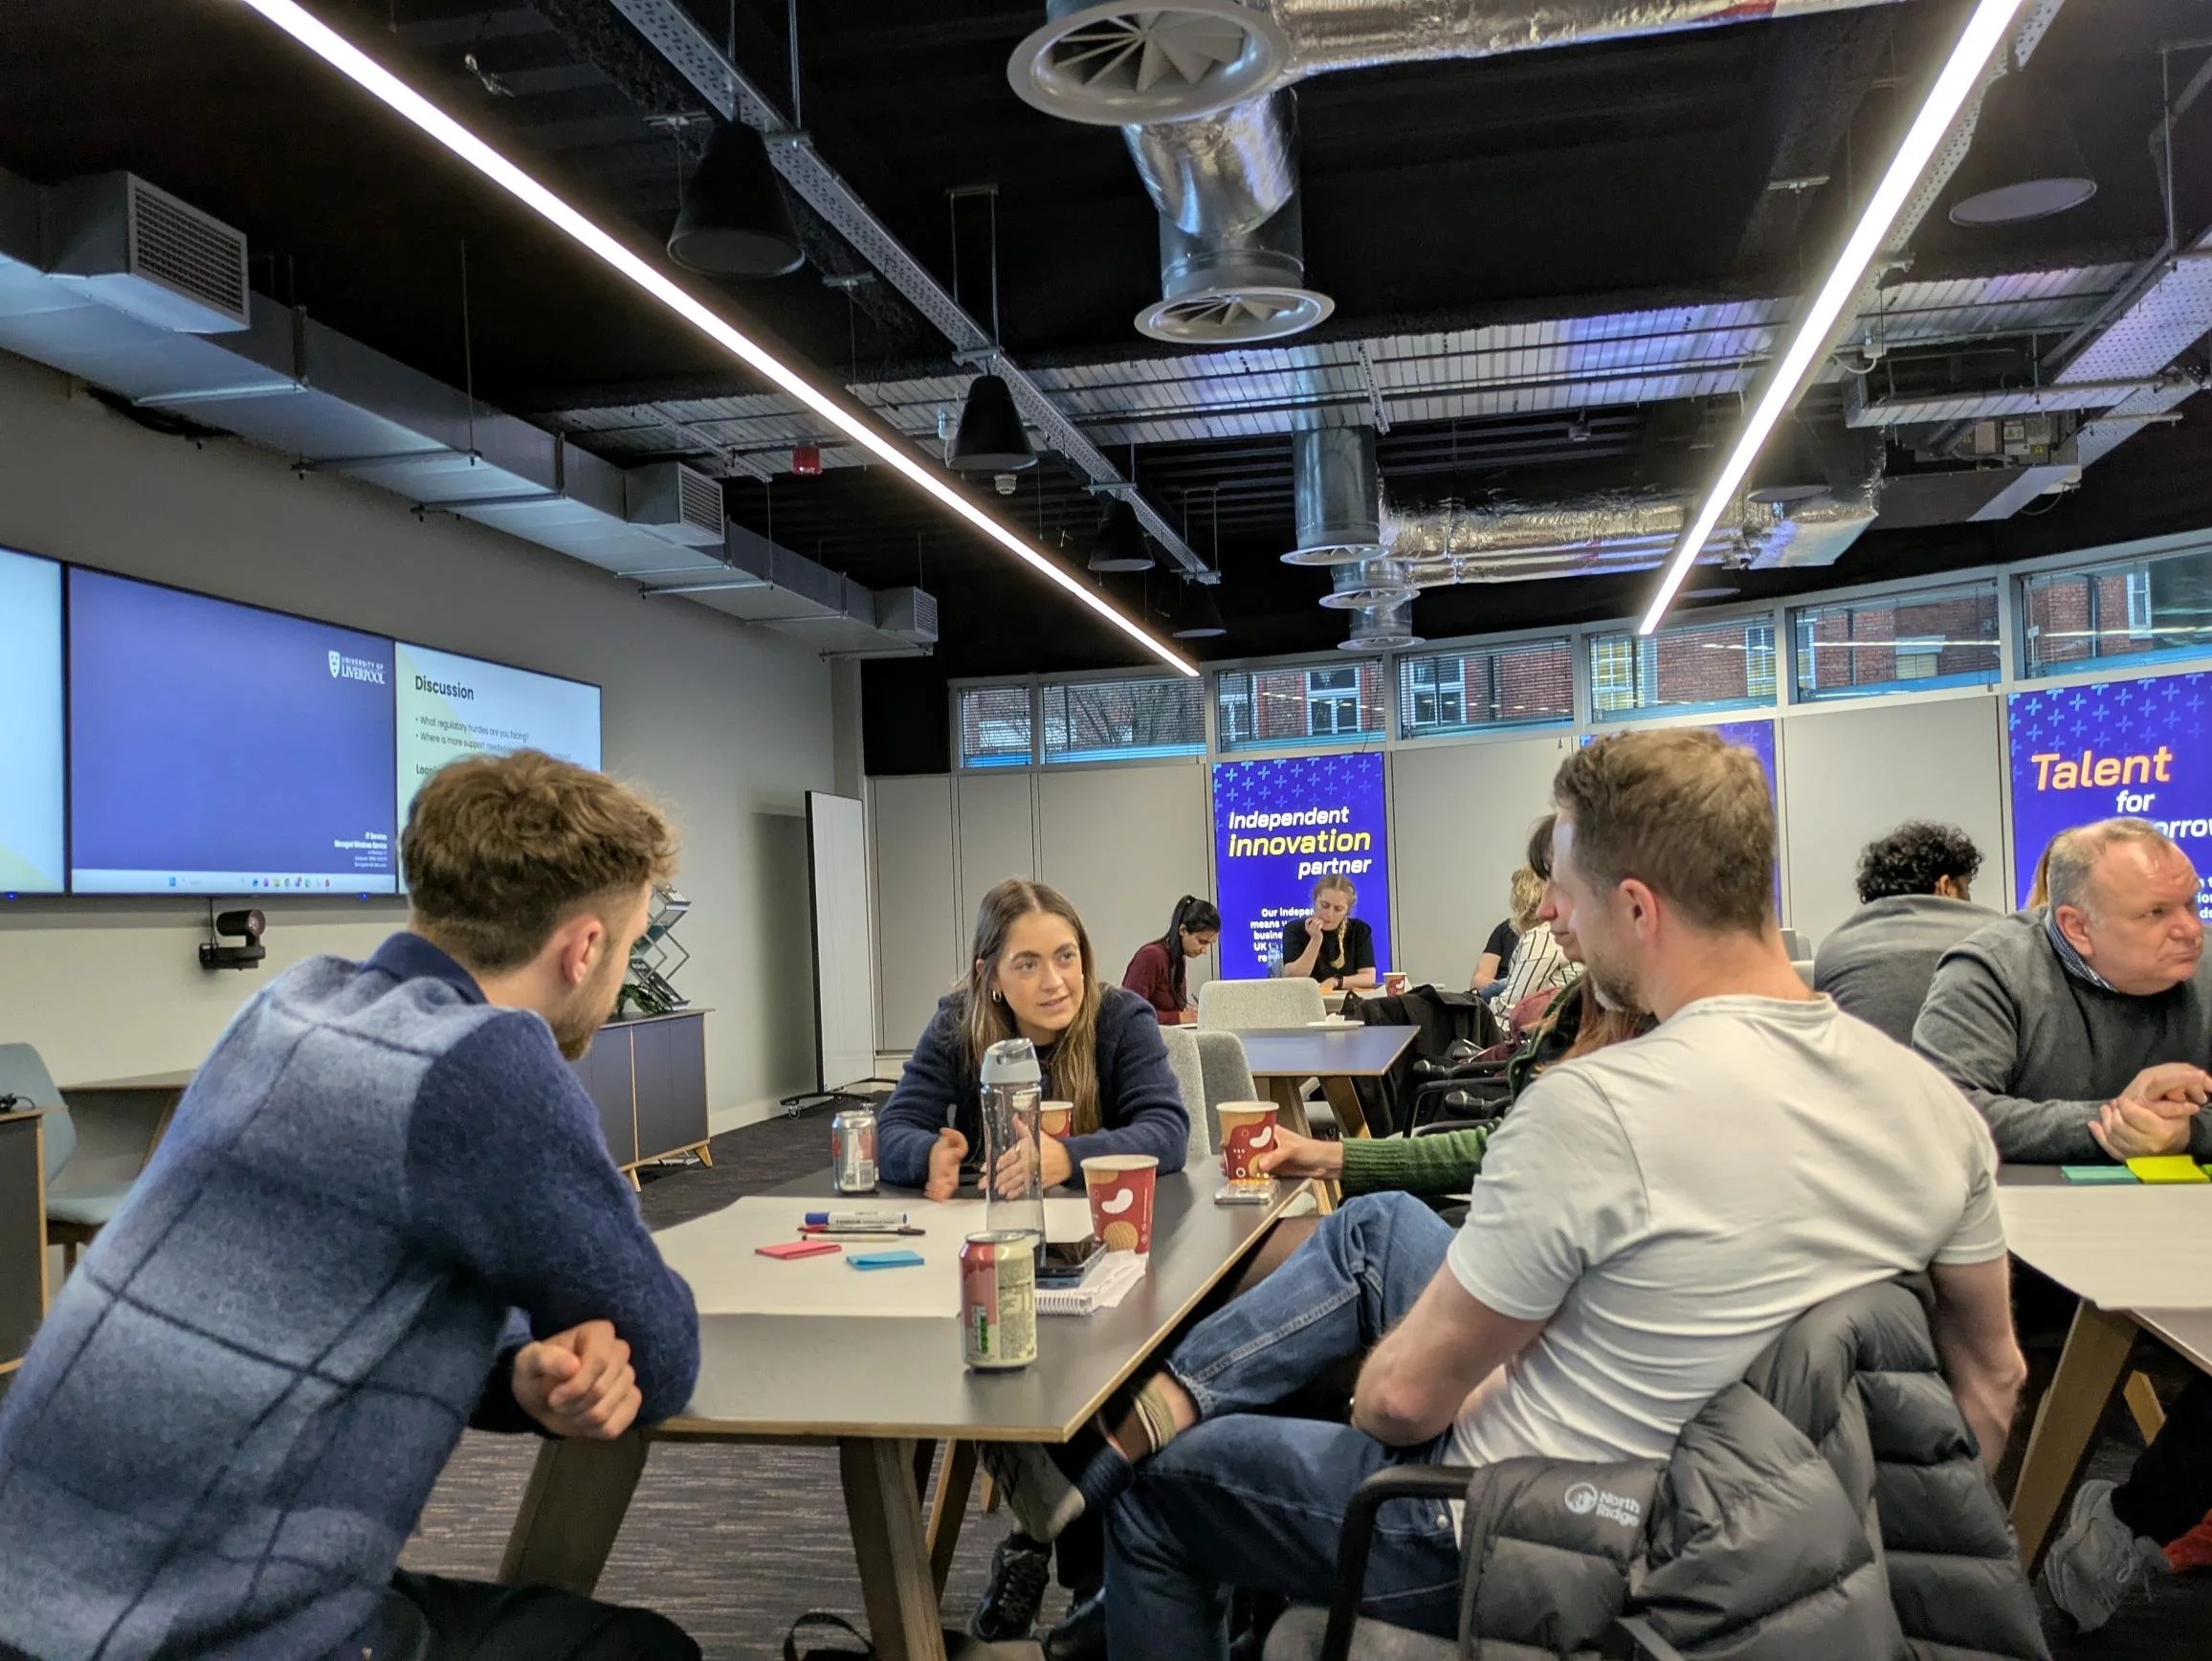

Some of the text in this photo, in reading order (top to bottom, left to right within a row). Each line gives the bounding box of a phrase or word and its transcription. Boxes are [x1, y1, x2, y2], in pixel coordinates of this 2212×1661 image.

[342, 664, 386, 684] LIVERPOOL
[415, 675, 475, 700] Discussion
[420, 716, 436, 726] What
[437, 720, 467, 735] regulatory
[490, 727, 498, 737] are
[499, 730, 510, 740] you
[420, 732, 440, 742] Where
[447, 737, 462, 746] more
[463, 740, 485, 750] support
[2031, 746, 2173, 791] Talent
[2116, 789, 2156, 813] for
[1228, 829, 1371, 857] innovation
[1297, 857, 1372, 880] partner
[1250, 920, 1280, 929] means
[1261, 908, 1277, 918] Our
[1253, 942, 1267, 952] UK
[1596, 1503, 1639, 1527] Ridge
[1600, 1491, 1640, 1516] North
